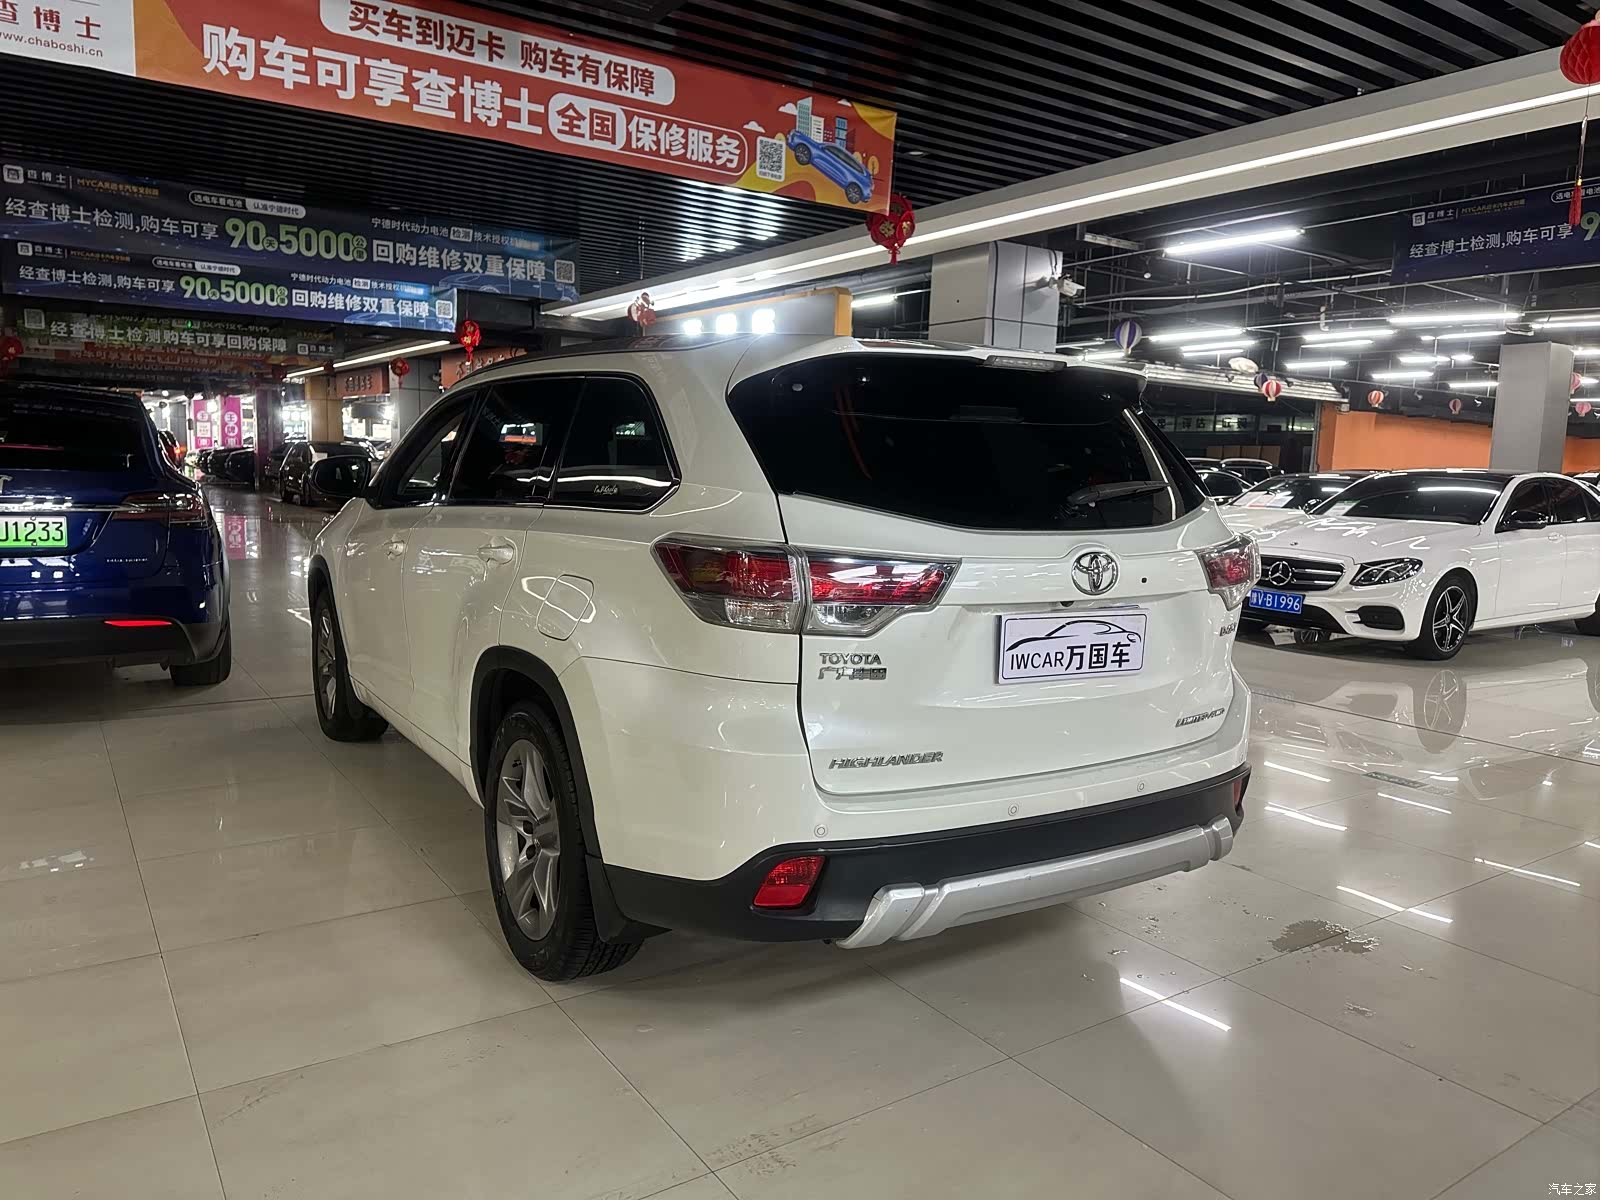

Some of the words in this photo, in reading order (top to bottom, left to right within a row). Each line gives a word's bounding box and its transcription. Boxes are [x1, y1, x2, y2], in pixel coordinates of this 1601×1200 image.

[0, 0, 101, 40] 查博士
[0, 31, 103, 57] ww.chaboshi.cn
[349, 1, 505, 62] 买车到迈卡
[519, 39, 655, 97] 购车有保障
[202, 23, 545, 136] 购车可享查博士
[555, 101, 617, 145] 全国
[627, 115, 742, 169] 保修服务
[371, 217, 449, 238] 宁德时代动力电池
[372, 239, 546, 281] 回购维修双重保障
[292, 289, 429, 318] 回购维修双重保障
[819, 652, 882, 665] TOYOTA
[1010, 641, 1131, 672] IWCAR万国车
[828, 751, 943, 769] HIGHLANDER
